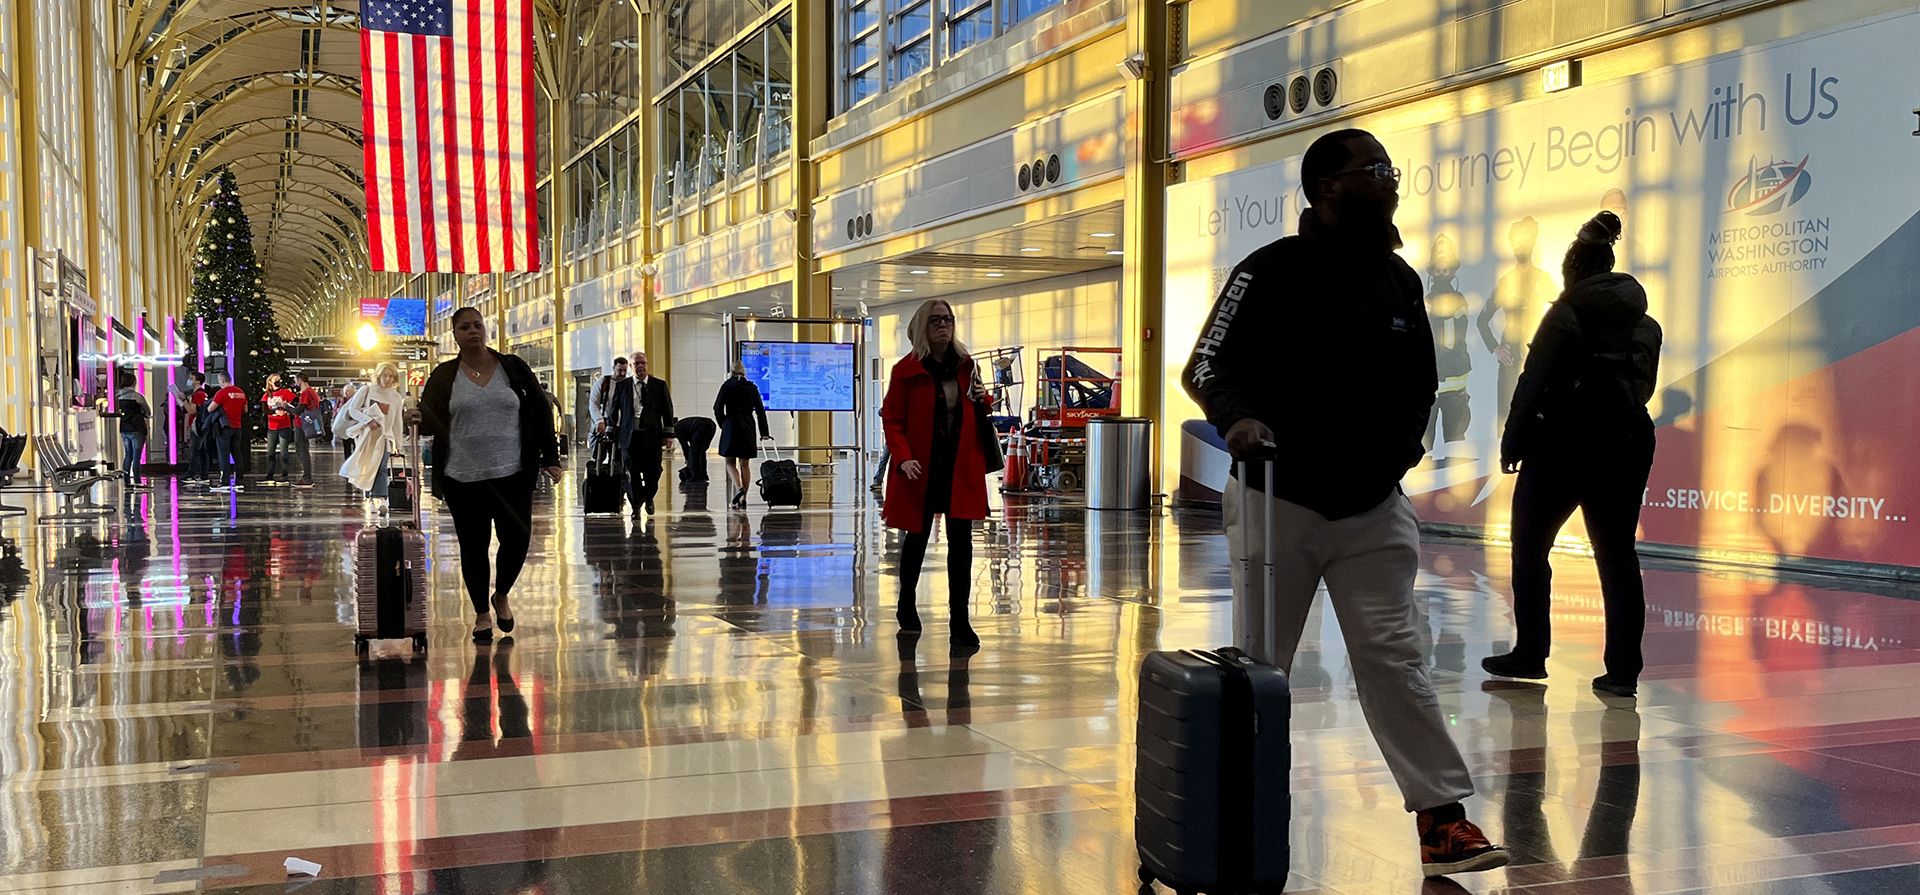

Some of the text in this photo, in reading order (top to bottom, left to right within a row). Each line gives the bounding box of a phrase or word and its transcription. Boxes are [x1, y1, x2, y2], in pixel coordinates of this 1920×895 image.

[1198, 200, 1229, 238] Let
[1234, 192, 1289, 231] Your
[1401, 141, 1536, 201] Journey
[1546, 107, 1657, 174] Begin
[1669, 82, 1766, 147] with
[1785, 67, 1839, 126] Us
[1708, 217, 1829, 245] METROPOLITAN
[1708, 236, 1829, 263] WASHINGTON
[1707, 257, 1827, 280] AIRPORTS AUTHORITY
[1066, 410, 1100, 419] SKYJACK
